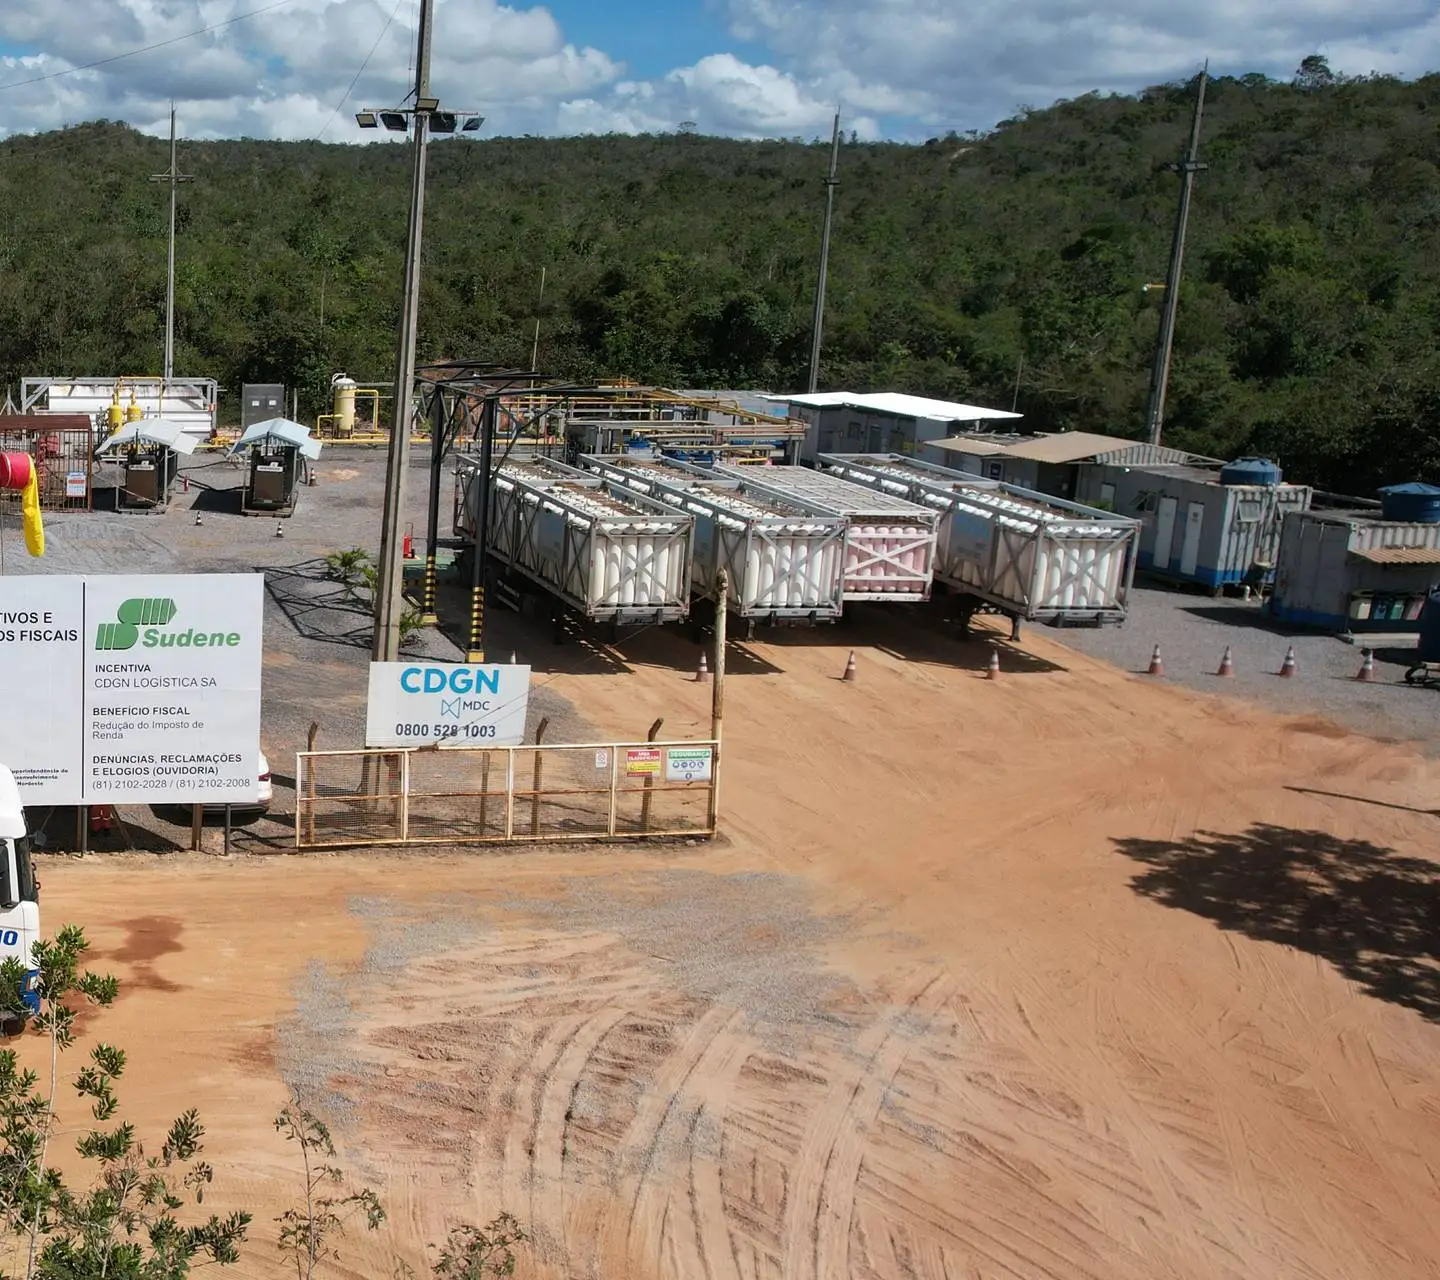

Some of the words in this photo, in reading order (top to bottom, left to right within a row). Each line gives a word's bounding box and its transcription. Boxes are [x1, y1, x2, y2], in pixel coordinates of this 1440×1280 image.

[43, 612, 52, 623] E
[20, 630, 78, 641] FISCAIS
[142, 628, 241, 647] Sudene
[95, 664, 151, 673] INCENTIVA
[94, 678, 130, 688] CDGN
[134, 676, 198, 688] LOGÍSTICA
[201, 677, 216, 687] SA
[400, 668, 500, 694] CDGN
[93, 705, 150, 716] BENEFÍCIO
[153, 707, 190, 715] FISCAL
[463, 701, 490, 710] MDC
[92, 721, 134, 731] Redução
[137, 721, 149, 730] do
[152, 721, 189, 731] Imposto
[192, 720, 204, 729] de
[396, 724, 429, 736] 0800
[434, 724, 458, 737] 528
[464, 724, 496, 738] 1003
[92, 731, 124, 740] Renda
[160, 752, 242, 764] RECLAMAÇÕES
[93, 767, 100, 776] E
[102, 766, 150, 776] ELOGIOS
[152, 766, 219, 776] (OUVIDORIA)
[92, 780, 112, 790] (81)
[115, 780, 167, 789] 2102-2028
[170, 780, 174, 788] /
[176, 779, 196, 789] (81)
[198, 778, 250, 788] 2102-2008
